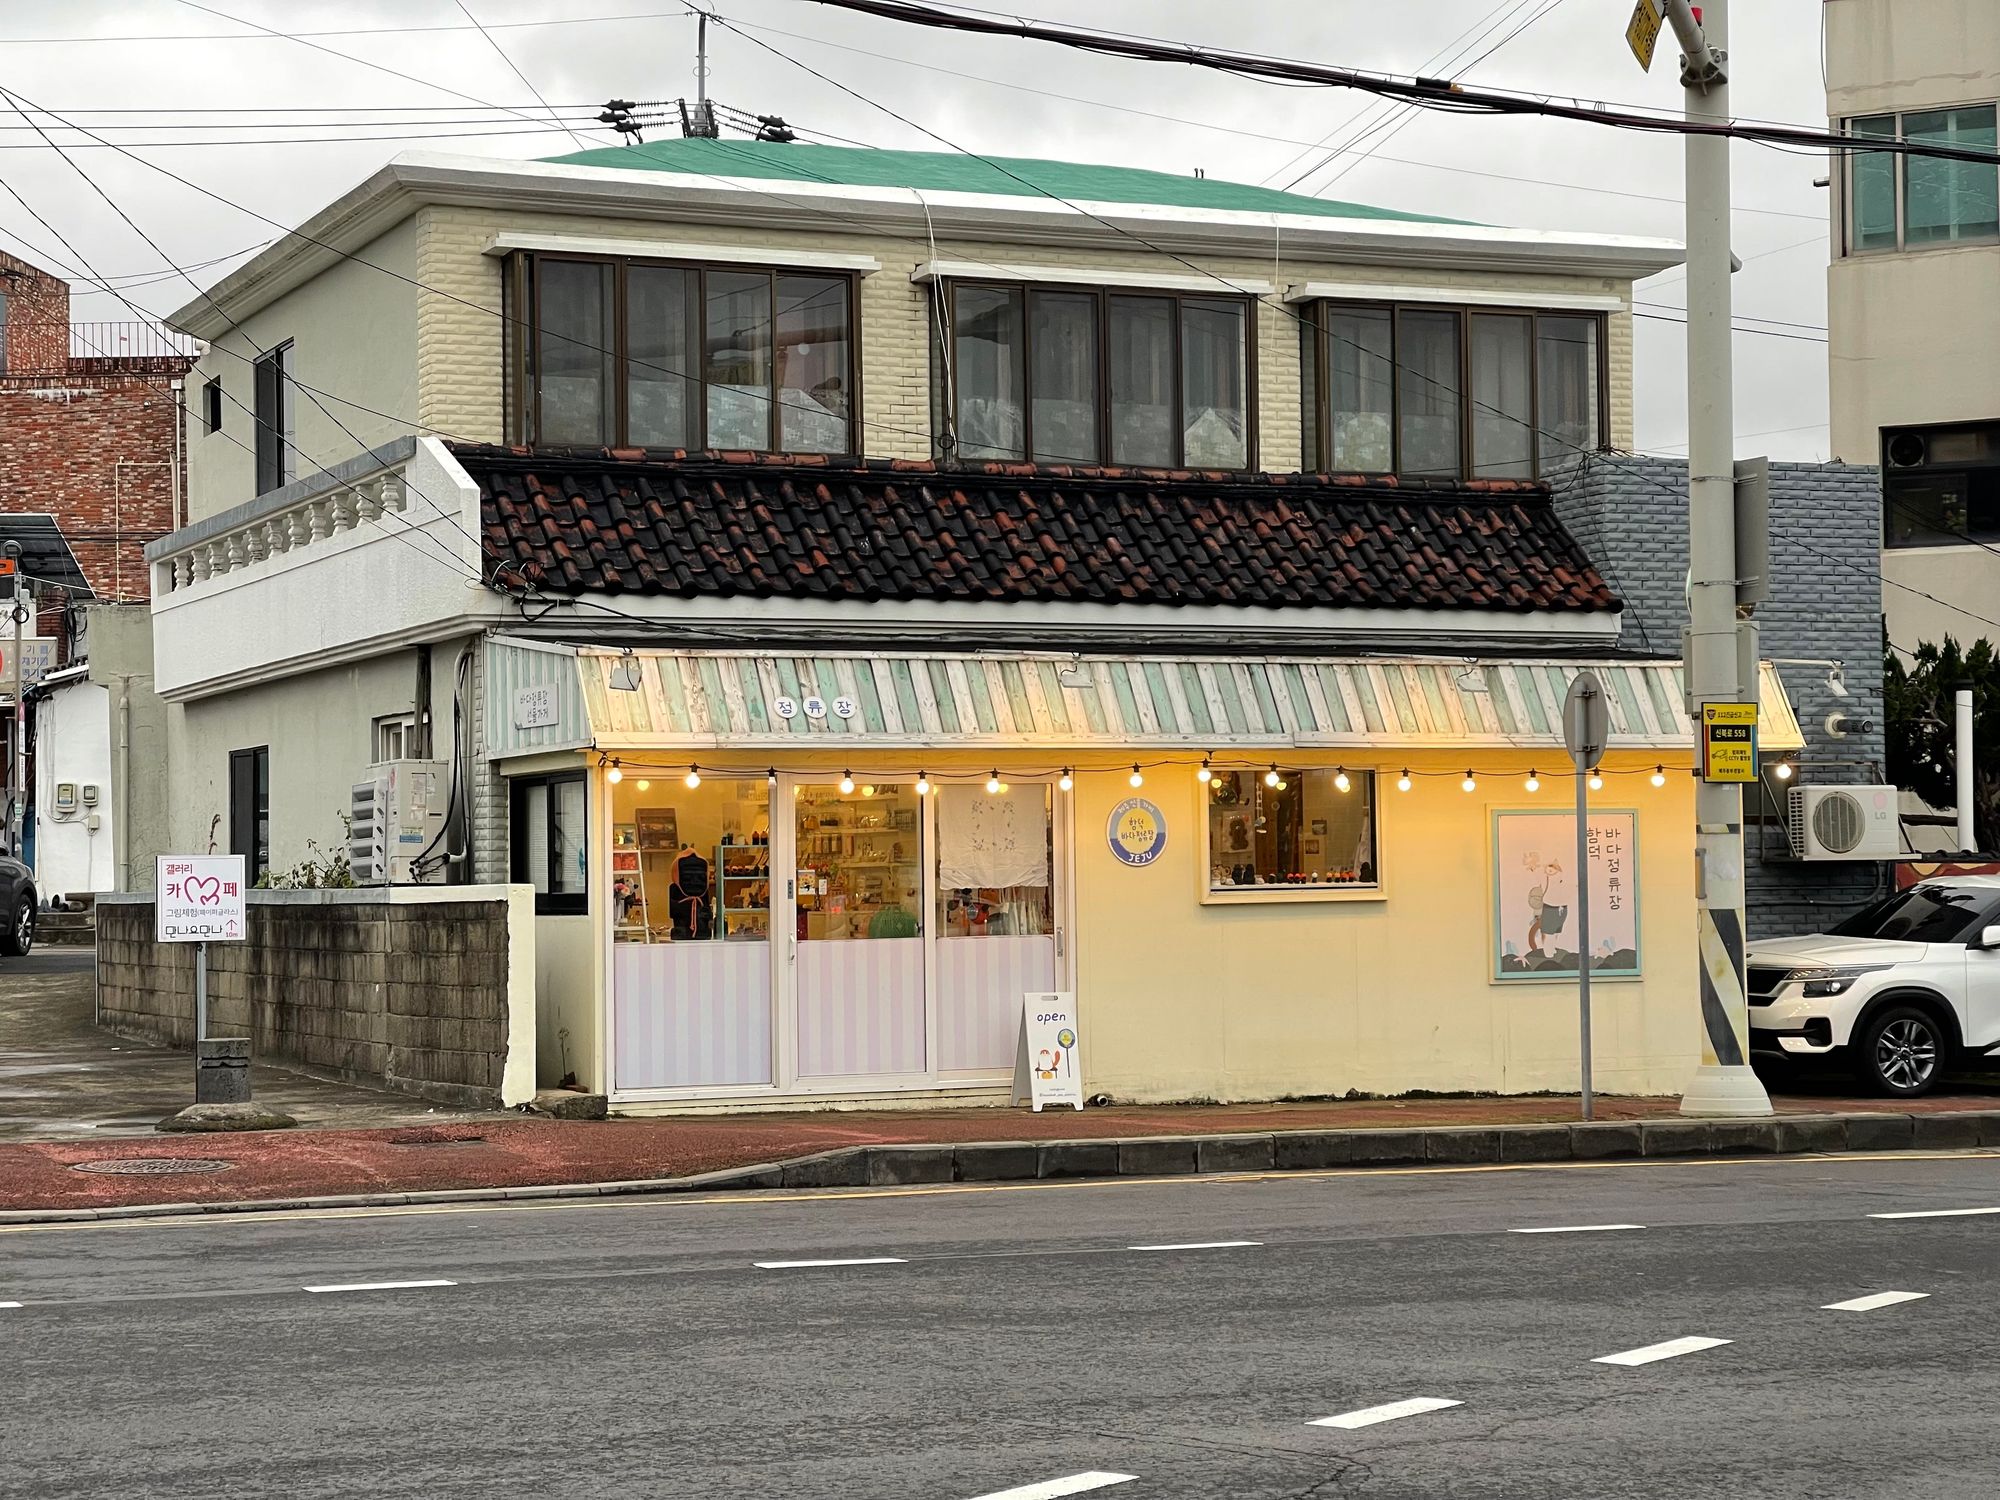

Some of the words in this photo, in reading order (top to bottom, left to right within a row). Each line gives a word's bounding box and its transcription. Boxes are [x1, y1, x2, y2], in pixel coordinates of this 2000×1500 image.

[1874, 812, 1887, 820] LG
[1586, 827, 1602, 861] 함덕
[1128, 851, 1153, 863] JEJU
[166, 864, 193, 875] 갤러리
[1604, 828, 1623, 911] 바다정류장
[1037, 1012, 1066, 1026] open
